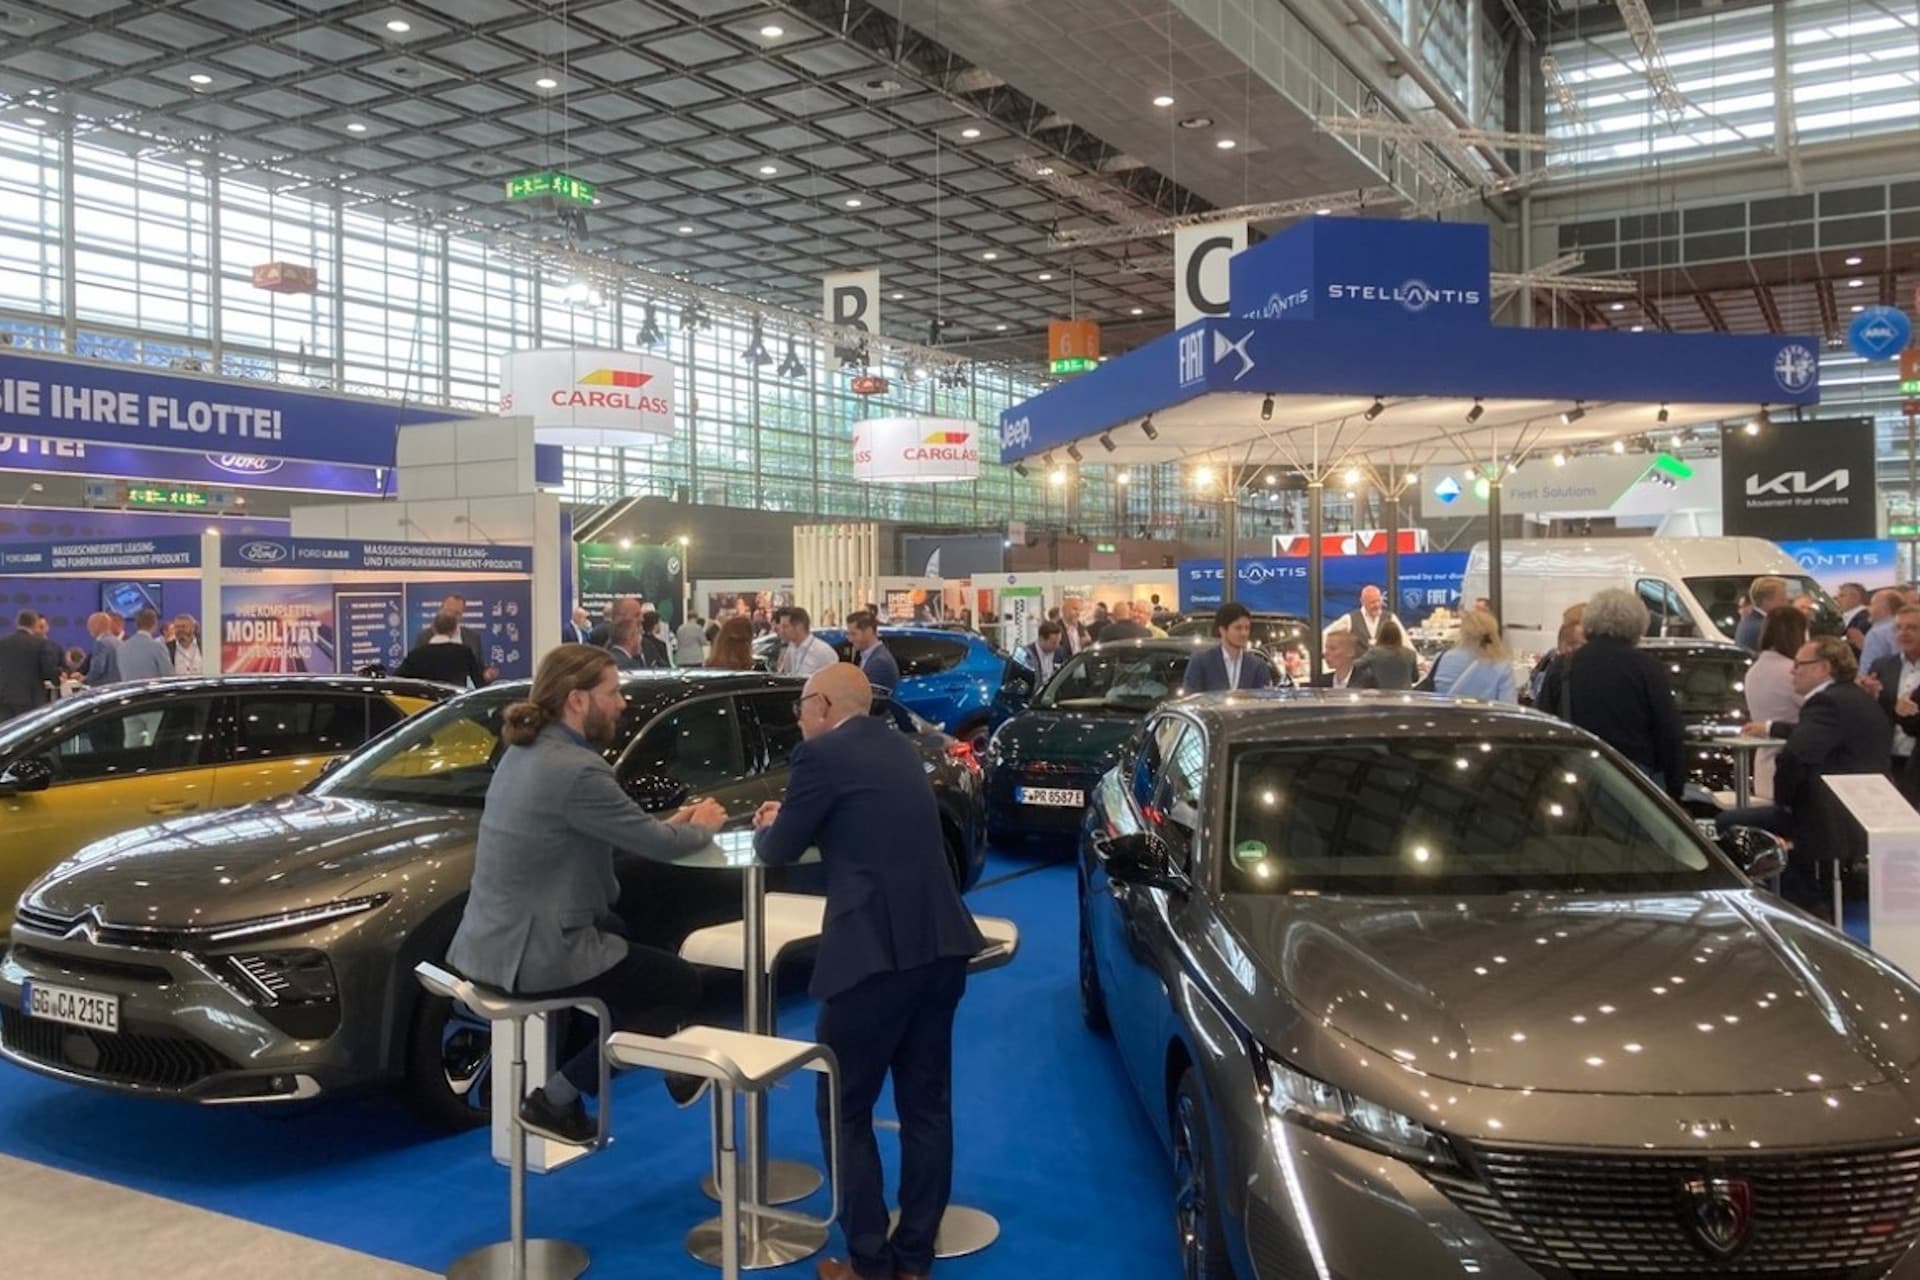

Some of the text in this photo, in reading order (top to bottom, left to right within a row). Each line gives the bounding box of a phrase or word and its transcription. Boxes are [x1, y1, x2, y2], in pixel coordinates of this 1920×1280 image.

[1186, 236, 1233, 315] C
[1328, 282, 1480, 308] STELLANTIS
[1060, 335, 1072, 356] 6
[1179, 328, 1205, 386] FIAT
[51, 384, 140, 426] IHRE
[148, 395, 282, 440] FLOTTE!
[551, 390, 668, 414] CARGLASS
[1000, 416, 1030, 449] Jeep
[1510, 486, 1597, 500] Fleet Solutions
[1794, 498, 1812, 506] that
[363, 556, 384, 566] UND
[1190, 564, 1307, 583] STELANTIS
[1427, 588, 1447, 605] FIAT
[226, 620, 321, 642] MOBILITÄT
